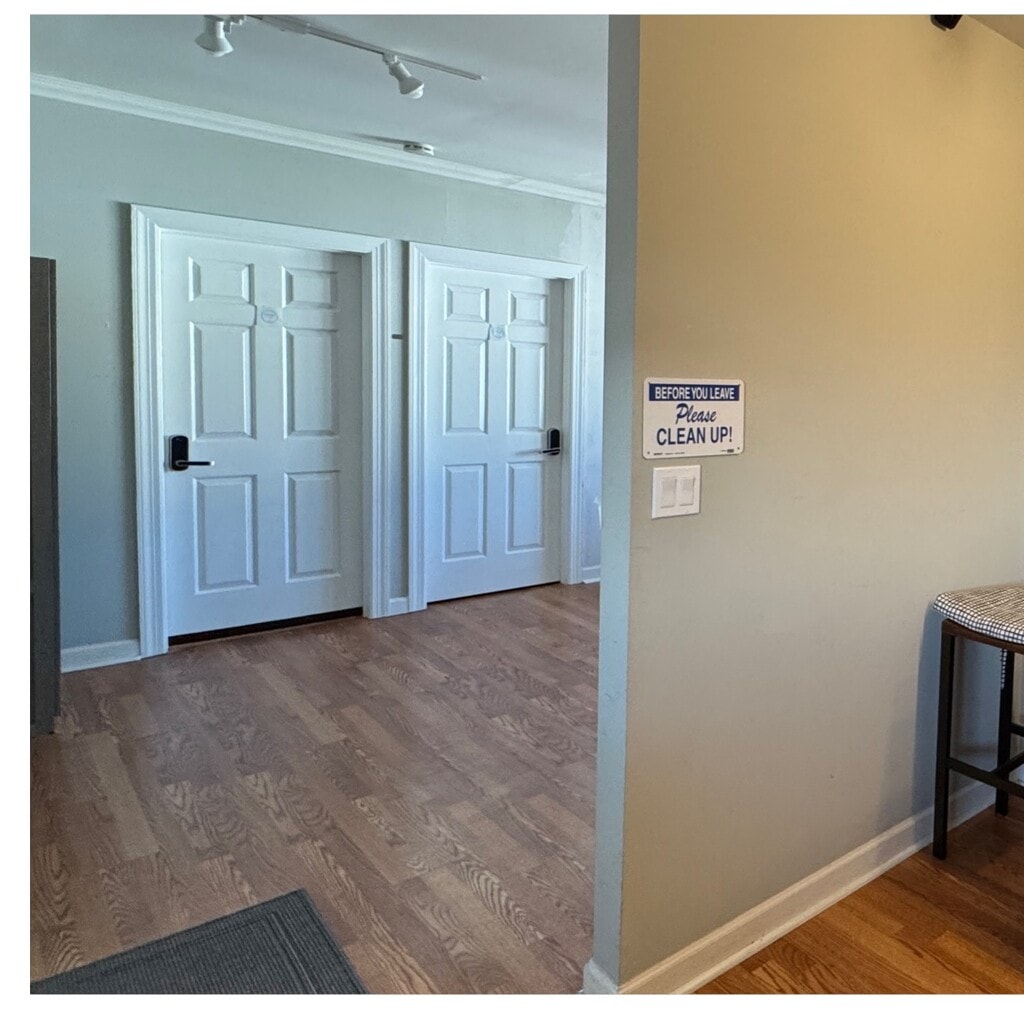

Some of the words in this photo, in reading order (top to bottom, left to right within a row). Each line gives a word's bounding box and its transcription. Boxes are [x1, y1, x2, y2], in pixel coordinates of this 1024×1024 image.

[655, 386, 690, 400] BEFORE
[691, 387, 708, 400] YOU
[710, 387, 735, 400] LEAVE
[675, 403, 717, 425] Please
[656, 427, 706, 446] CLEAN
[710, 426, 733, 443] UP!
